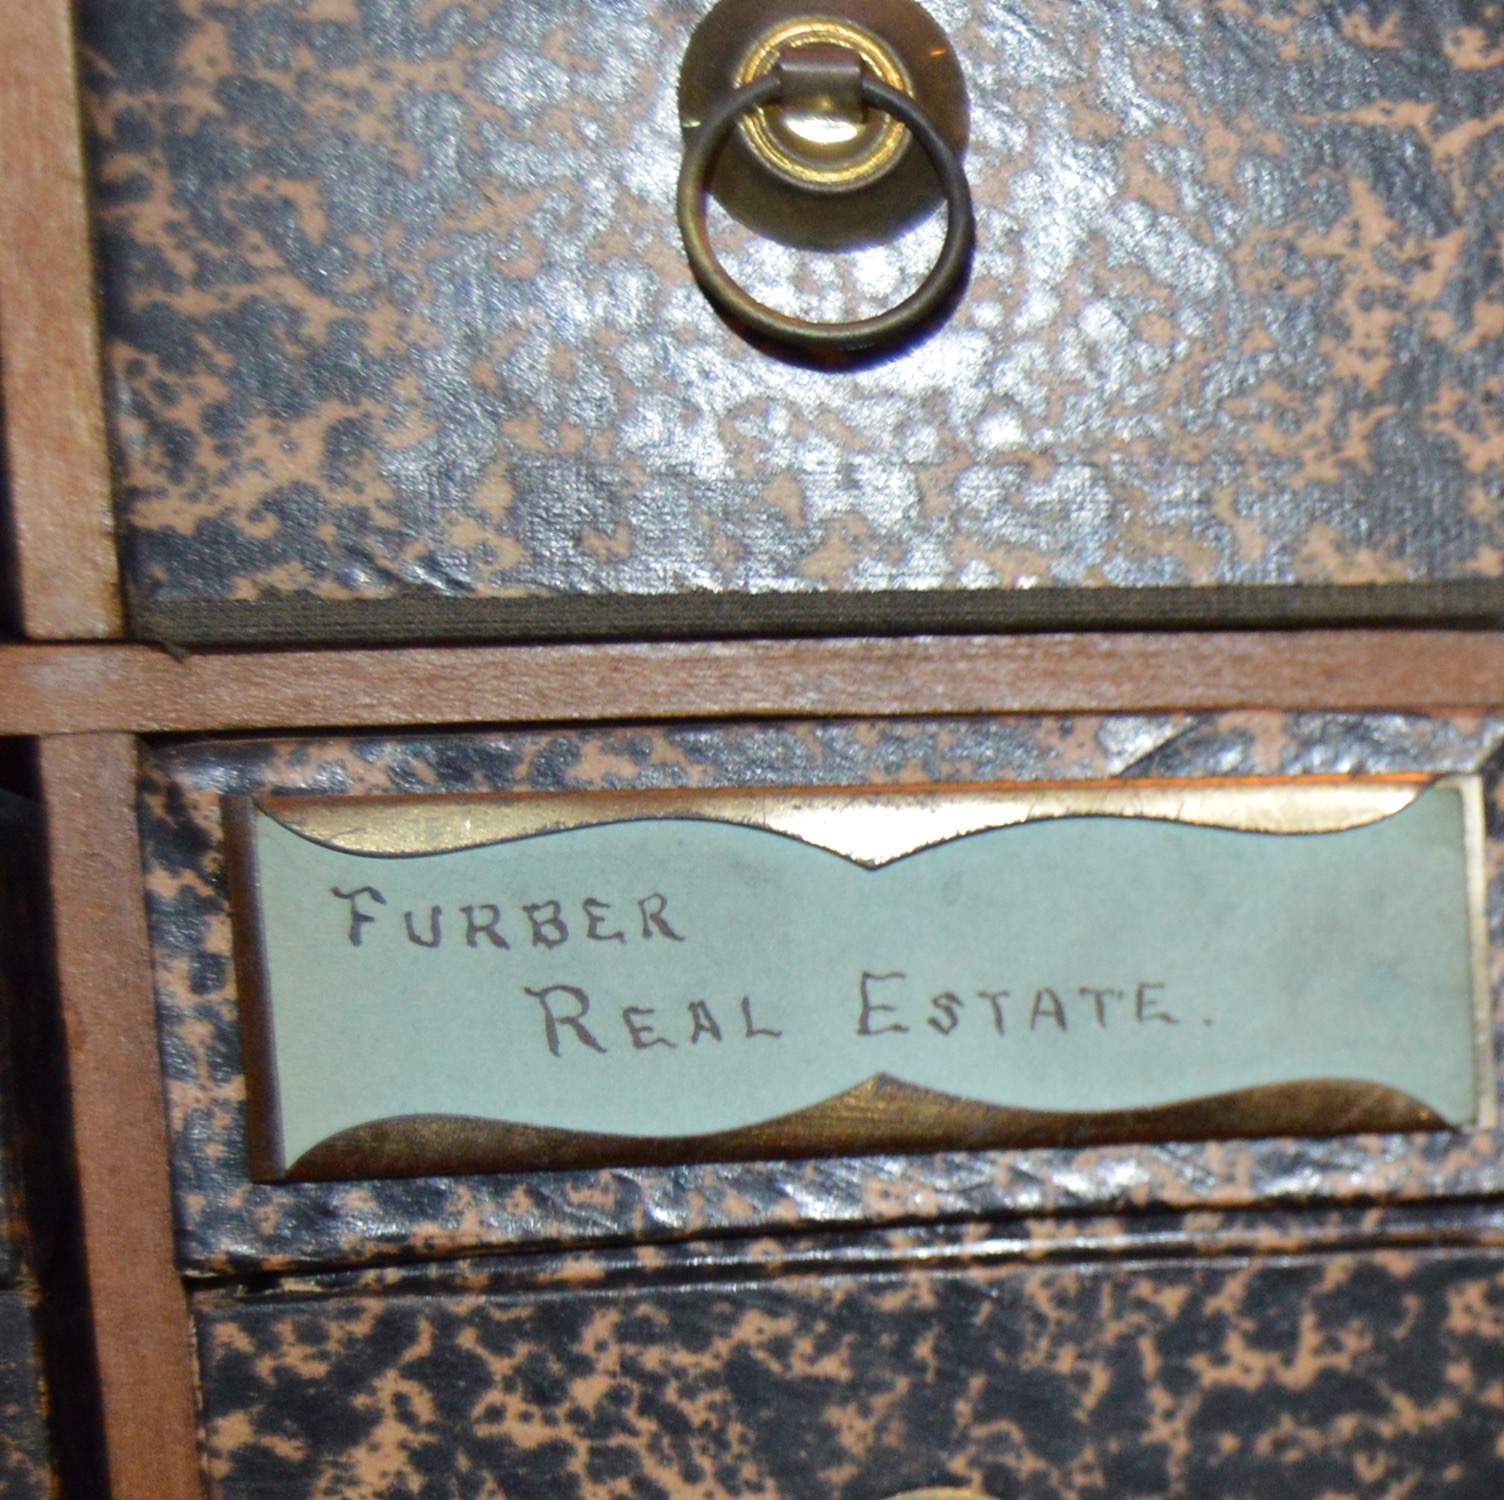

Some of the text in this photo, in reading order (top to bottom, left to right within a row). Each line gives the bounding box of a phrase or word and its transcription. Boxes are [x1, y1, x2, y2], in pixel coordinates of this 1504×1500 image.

[330, 885, 686, 950] FURBER
[523, 970, 1212, 1057] REAL ESTATE.
